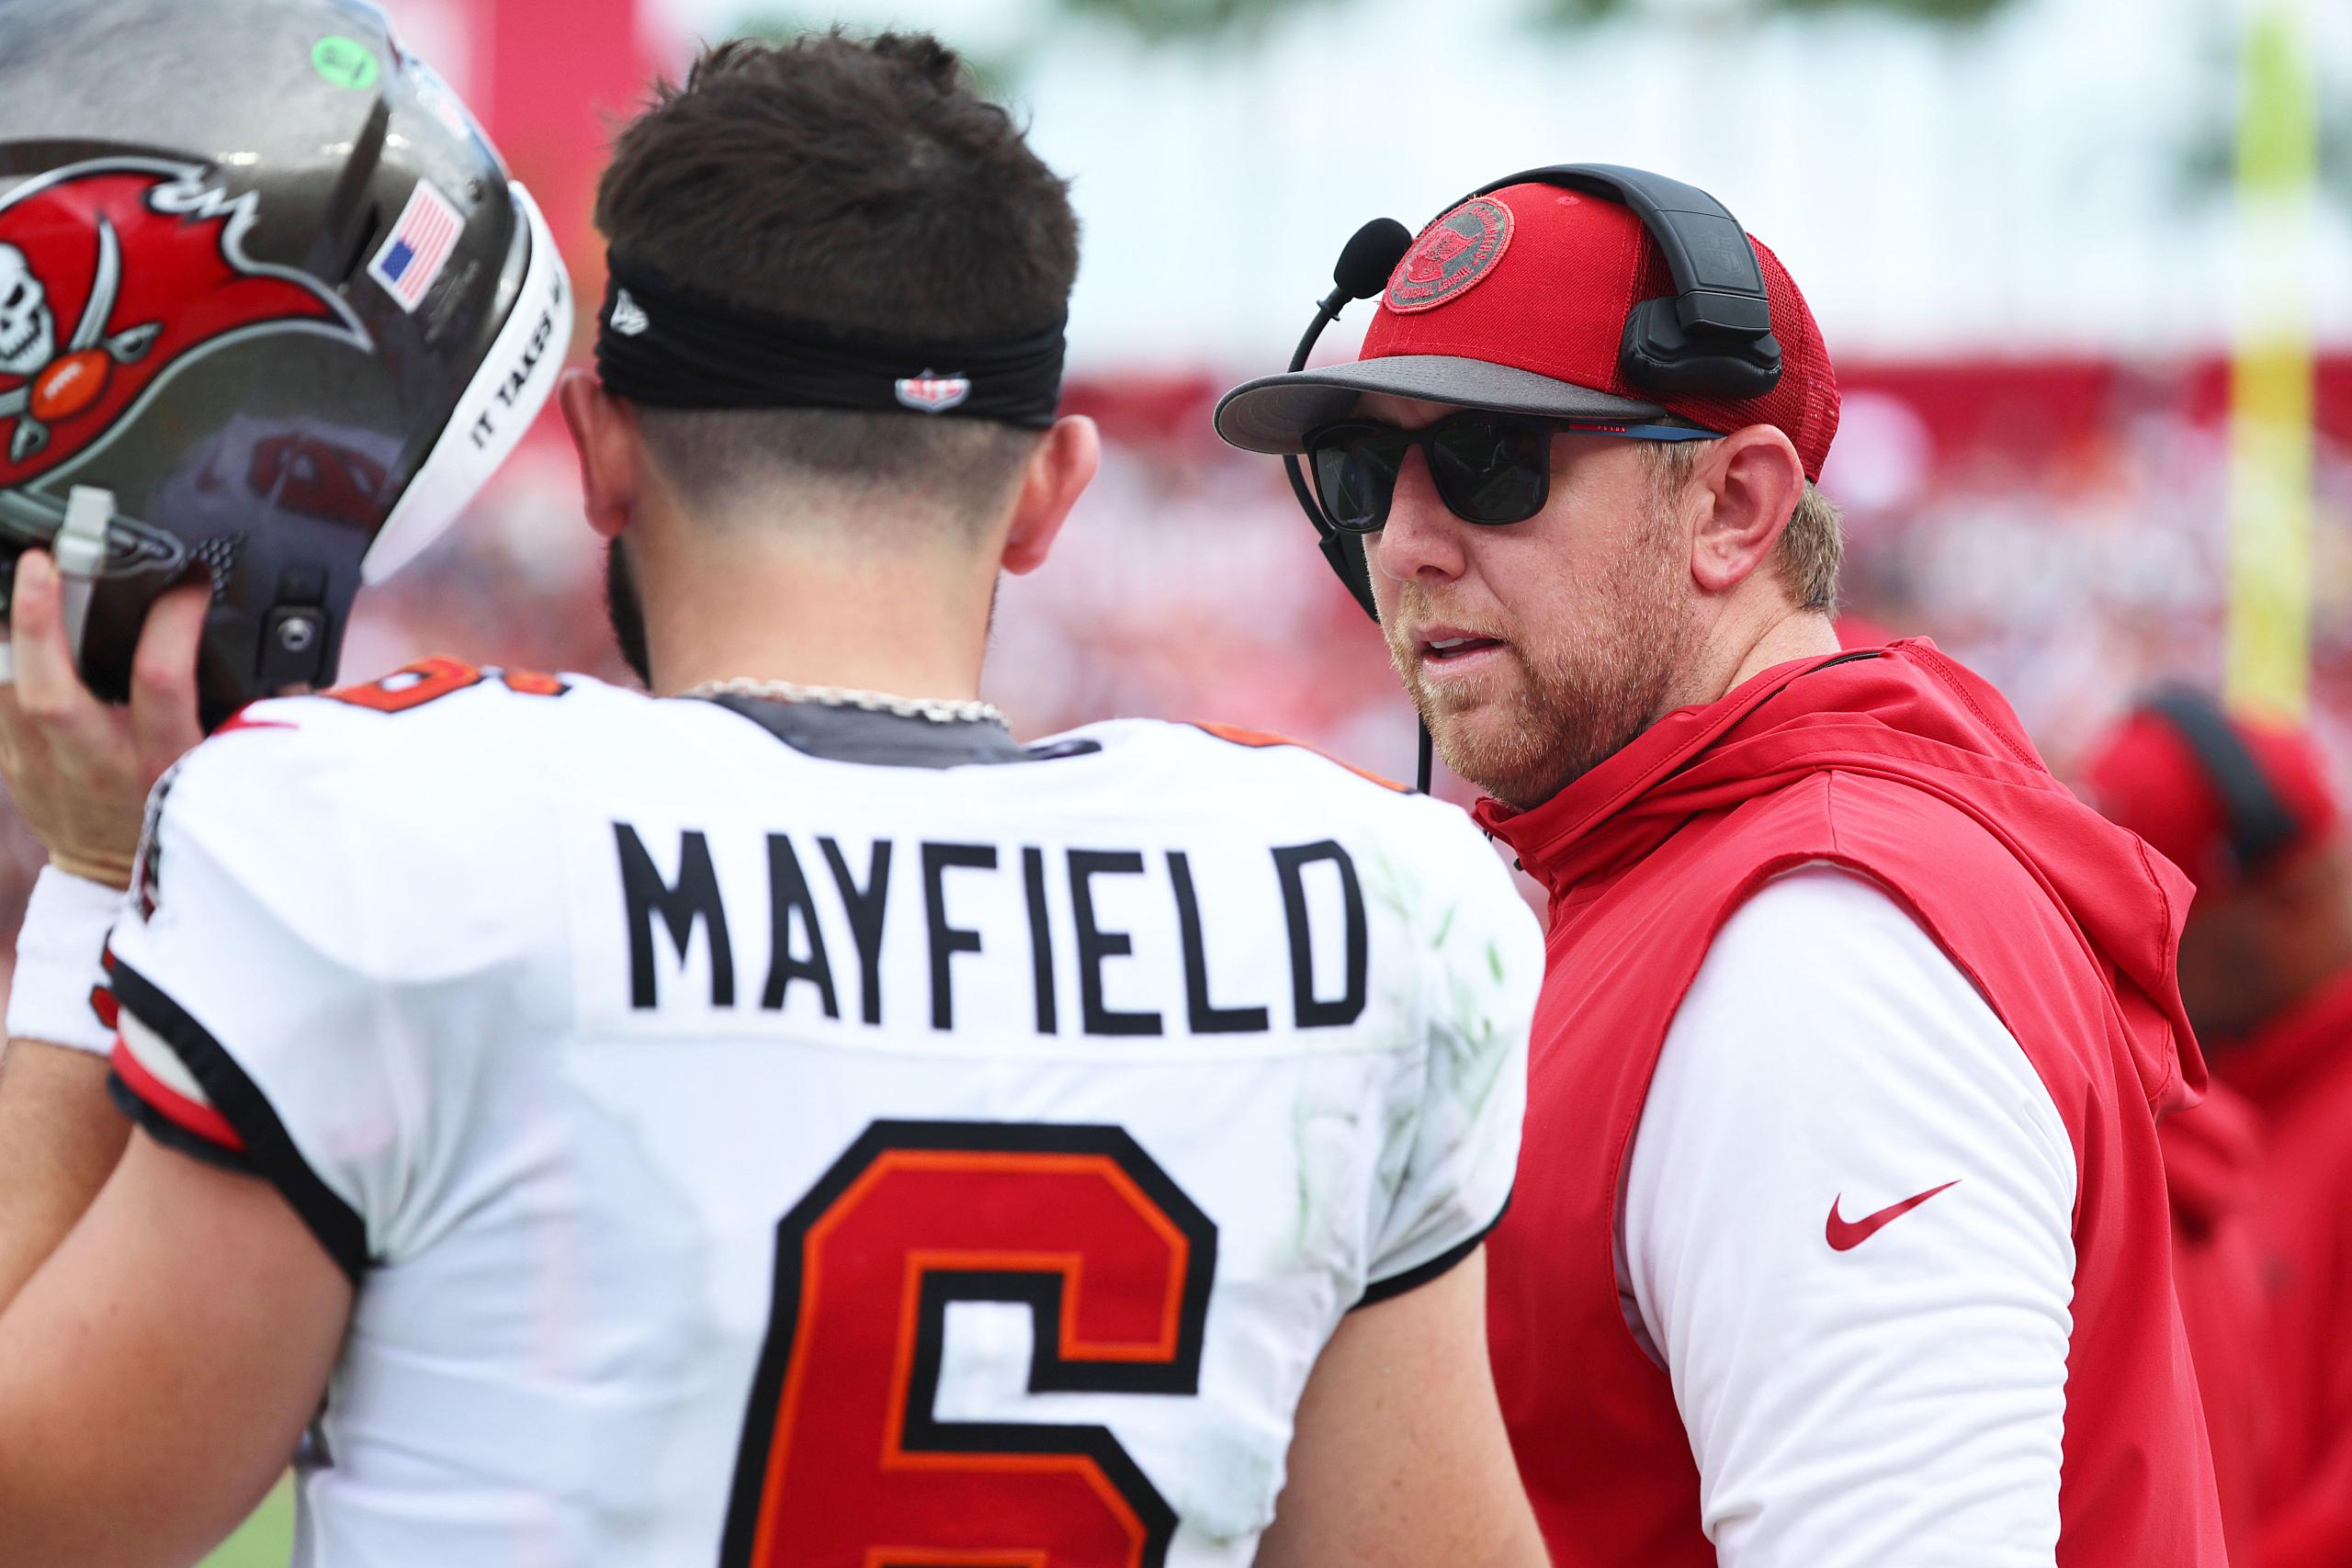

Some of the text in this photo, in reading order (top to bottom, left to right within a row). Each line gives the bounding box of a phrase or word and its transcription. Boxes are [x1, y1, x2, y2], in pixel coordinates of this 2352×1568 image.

[471, 412, 493, 449] IT
[613, 821, 1368, 1036] MAYFIELD
[718, 1119, 1218, 1568] 6
